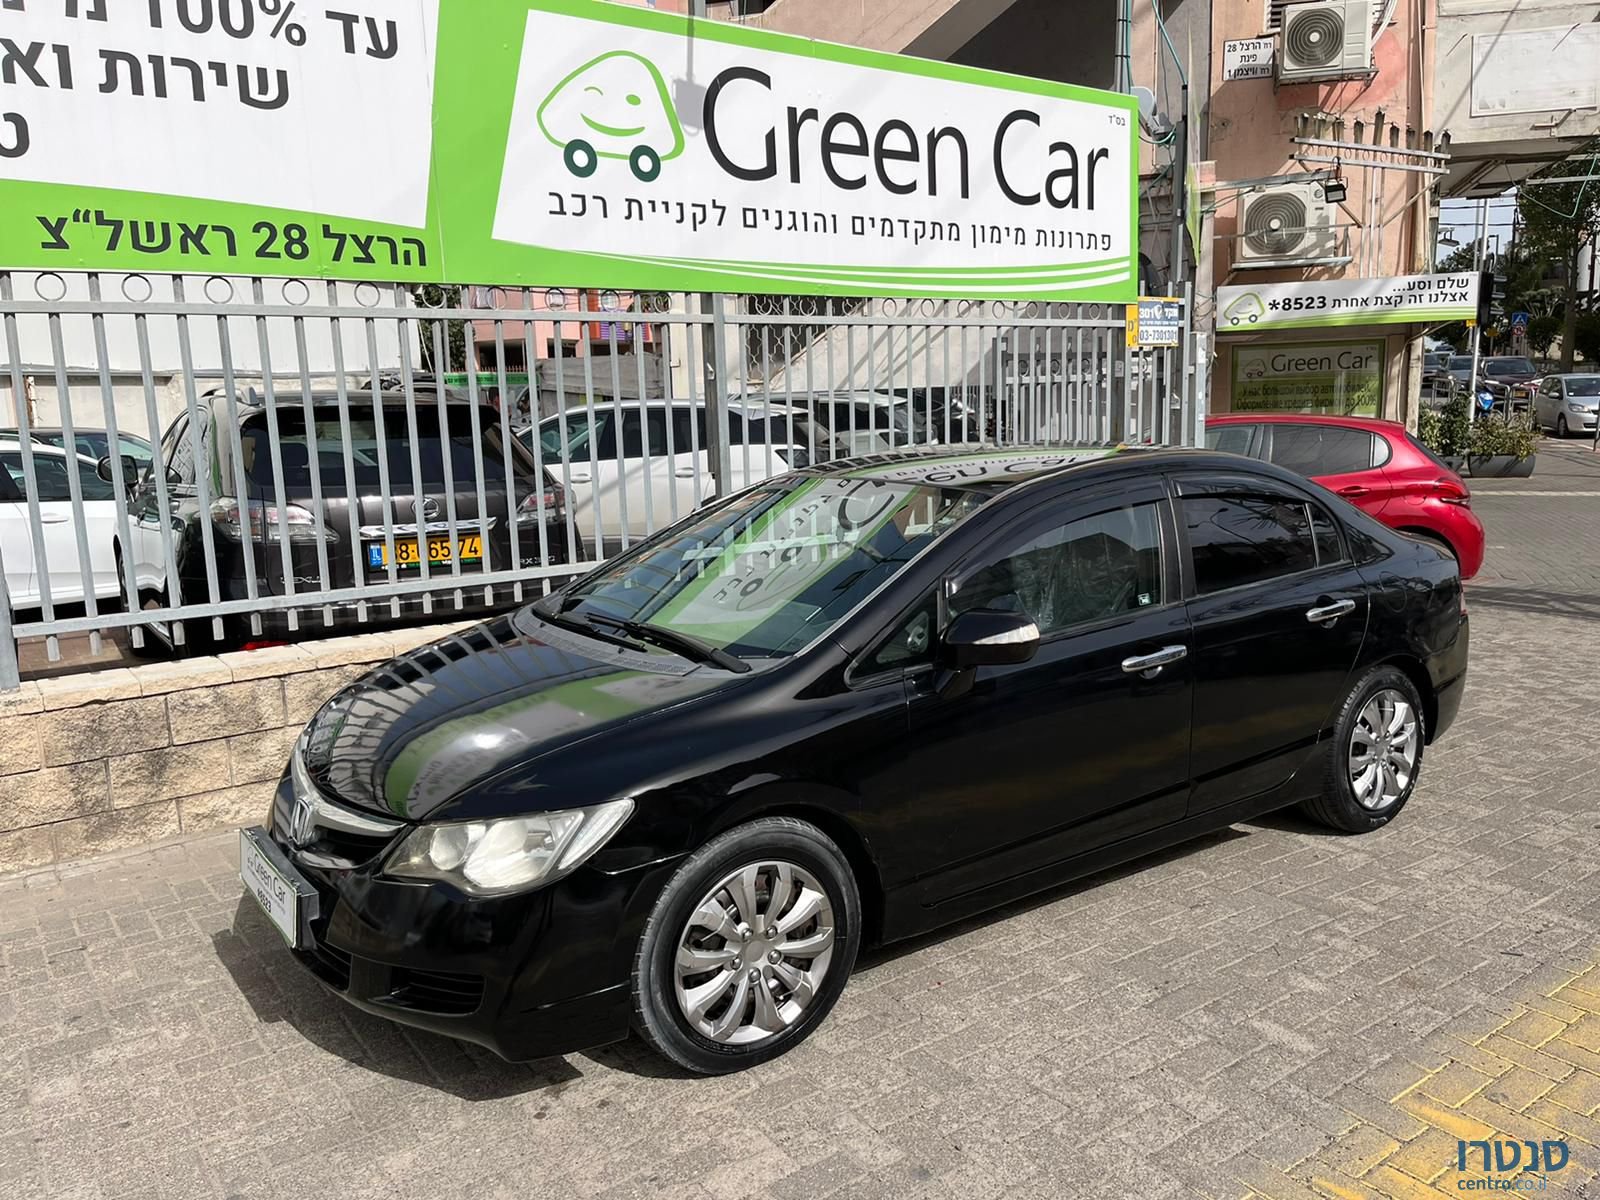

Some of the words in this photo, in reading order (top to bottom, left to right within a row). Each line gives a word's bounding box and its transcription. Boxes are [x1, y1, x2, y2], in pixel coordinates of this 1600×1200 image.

[325, 10, 398, 60] עד
[1240, 42, 1261, 51] הרצל
[1227, 44, 1237, 52] 28
[1240, 54, 1257, 63] פינת
[98, 47, 290, 110] שירות
[1234, 67, 1258, 78] וויצמן
[703, 66, 970, 200] Green
[993, 110, 1110, 211] Car
[548, 191, 609, 219] רכב
[624, 198, 727, 232] לקניית
[742, 206, 838, 234] והוגנים
[851, 215, 961, 245] מתקדמים
[252, 221, 310, 260] 28
[322, 223, 427, 267] הרצל
[971, 223, 1026, 248] מימון
[1036, 228, 1112, 251] פתרונות
[1437, 277, 1470, 290] שלם
[1331, 297, 1369, 309] אחרת
[1374, 295, 1403, 309] קצת
[1408, 293, 1424, 304] זה
[1429, 290, 1468, 304] אצלנו
[1139, 308, 1154, 318] 301
[1271, 353, 1332, 373] Green
[1337, 351, 1373, 370] Car
[254, 852, 272, 891] Green
[273, 876, 286, 905] Car
